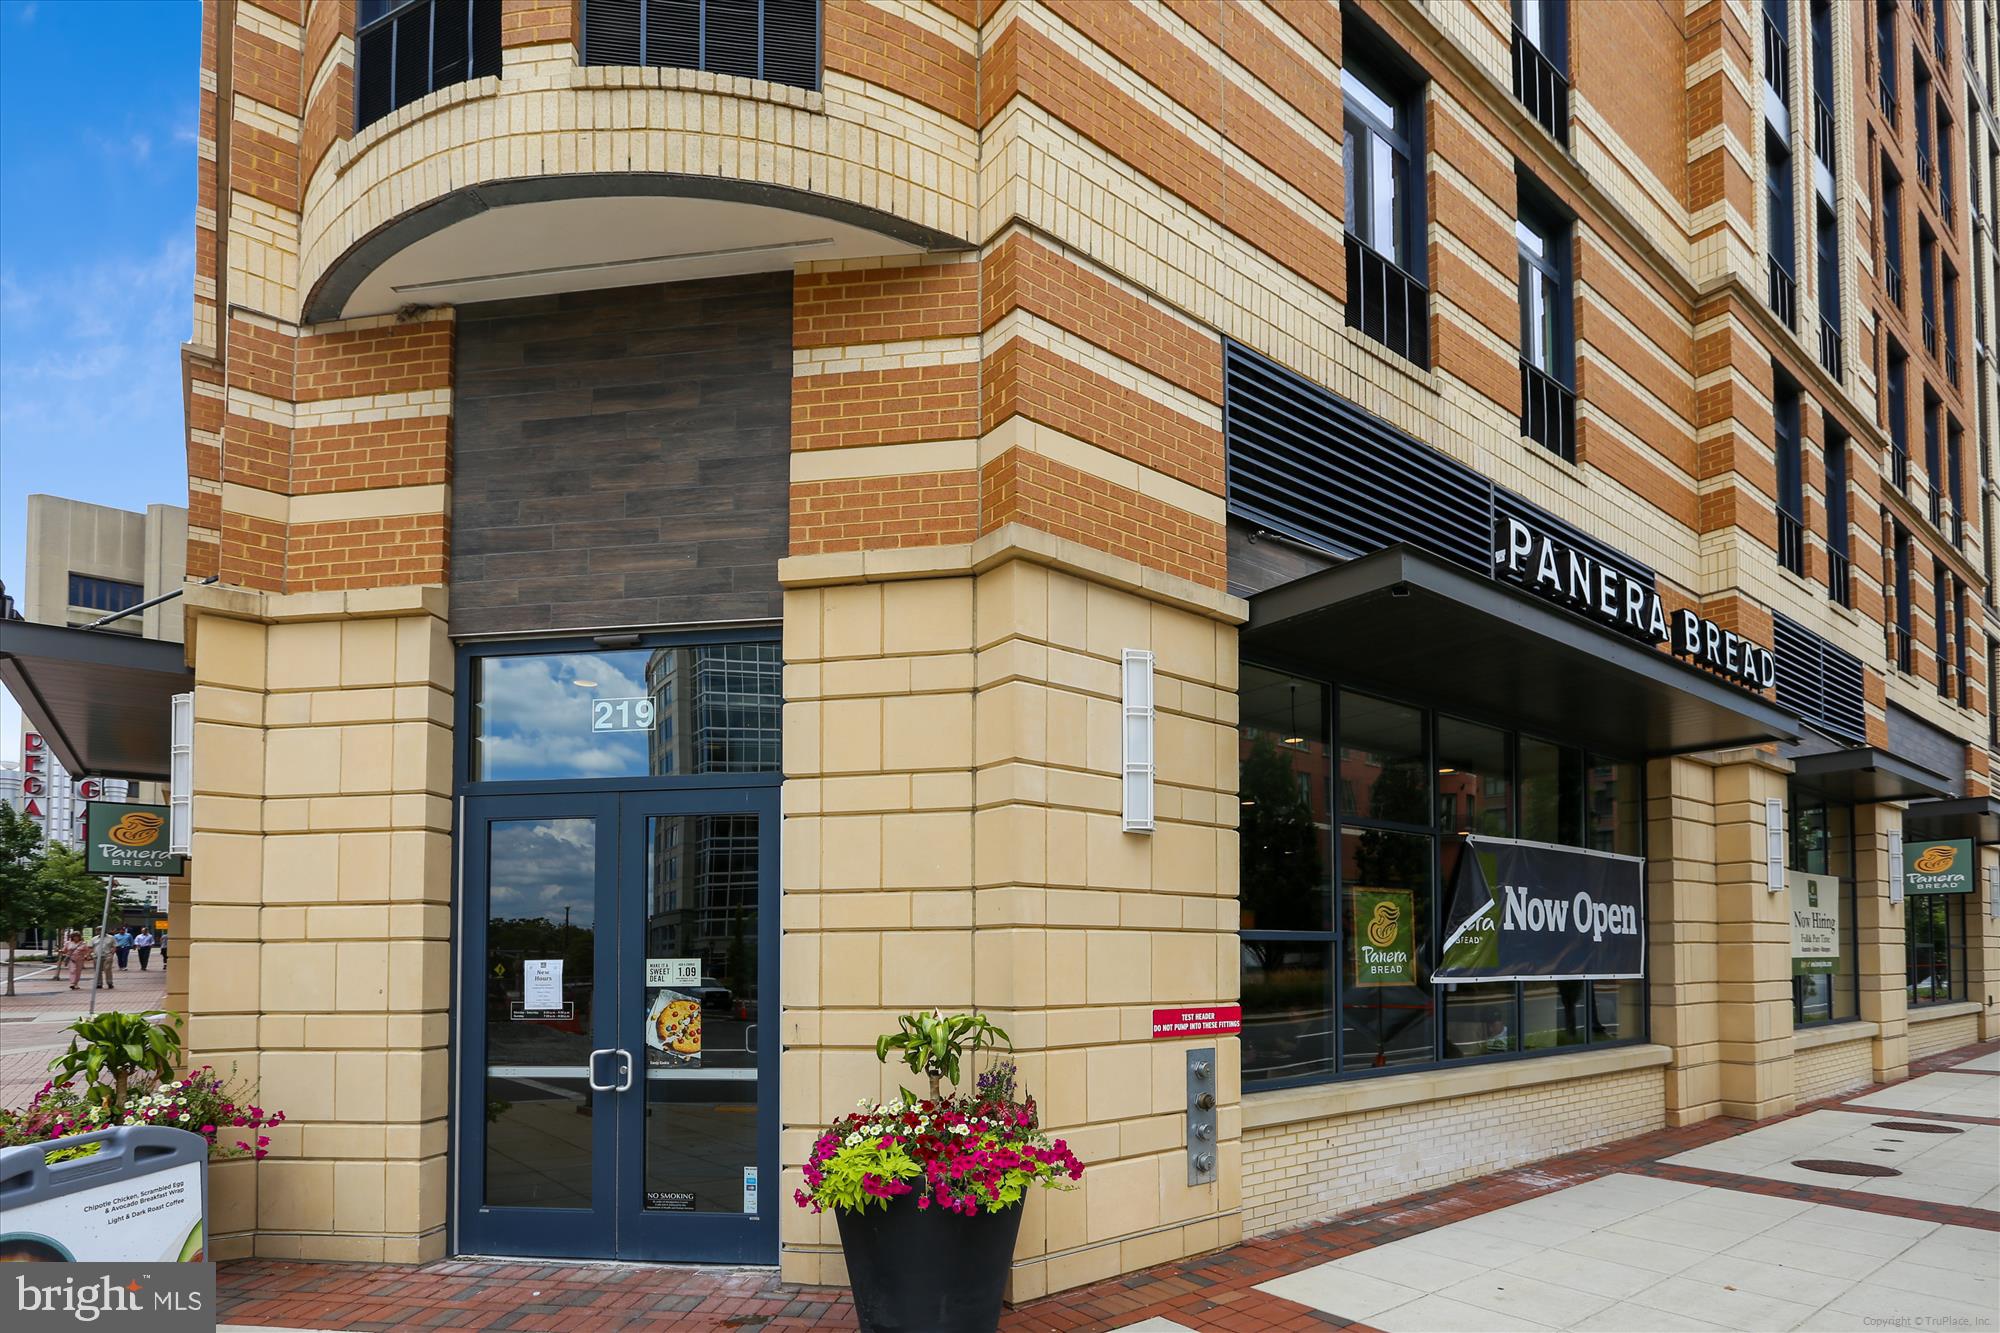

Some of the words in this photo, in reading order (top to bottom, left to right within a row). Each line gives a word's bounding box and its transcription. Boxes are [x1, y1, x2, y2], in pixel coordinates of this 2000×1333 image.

[1507, 517, 1669, 642] PANERA
[1683, 609, 1775, 688] BREAD
[594, 699, 654, 729] 219
[97, 843, 172, 860] Panera
[112, 859, 163, 868] BREAD
[1906, 872, 1965, 884] Panera
[1916, 882, 1958, 890] BREAD
[1503, 886, 1569, 932] Now
[1572, 891, 1638, 943] Open
[1793, 910, 1811, 929] Now
[1811, 911, 1836, 935] Hiring
[1361, 945, 1408, 964] Panera
[649, 967, 670, 975] SWEET
[678, 966, 697, 977] 1.09
[1371, 965, 1403, 974] BREAD
[649, 975, 665, 983] DEAL
[1181, 1013, 1194, 1021] TEST
[1195, 1012, 1216, 1020] HEADER
[1153, 1024, 1162, 1032] DO
[1162, 1023, 1173, 1032] NOT
[1174, 1023, 1189, 1031] PUMP
[1189, 1022, 1202, 1030] INTO
[1202, 1021, 1218, 1029] THESE
[1218, 1020, 1240, 1029] FITTINGS
[83, 1201, 112, 1212] Chipotle
[112, 1193, 140, 1205] Chicken,
[140, 1183, 172, 1197] Scrambled
[172, 1181, 184, 1189] Egg
[111, 1200, 139, 1212] Avocado
[139, 1192, 168, 1204] Breakfast
[169, 1187, 184, 1196] Wrap
[660, 1192, 694, 1200] SMOKING
[107, 1215, 125, 1225] Light
[131, 1208, 146, 1218] Dark
[147, 1204, 164, 1213] Roast
[165, 1198, 185, 1208] Coffee
